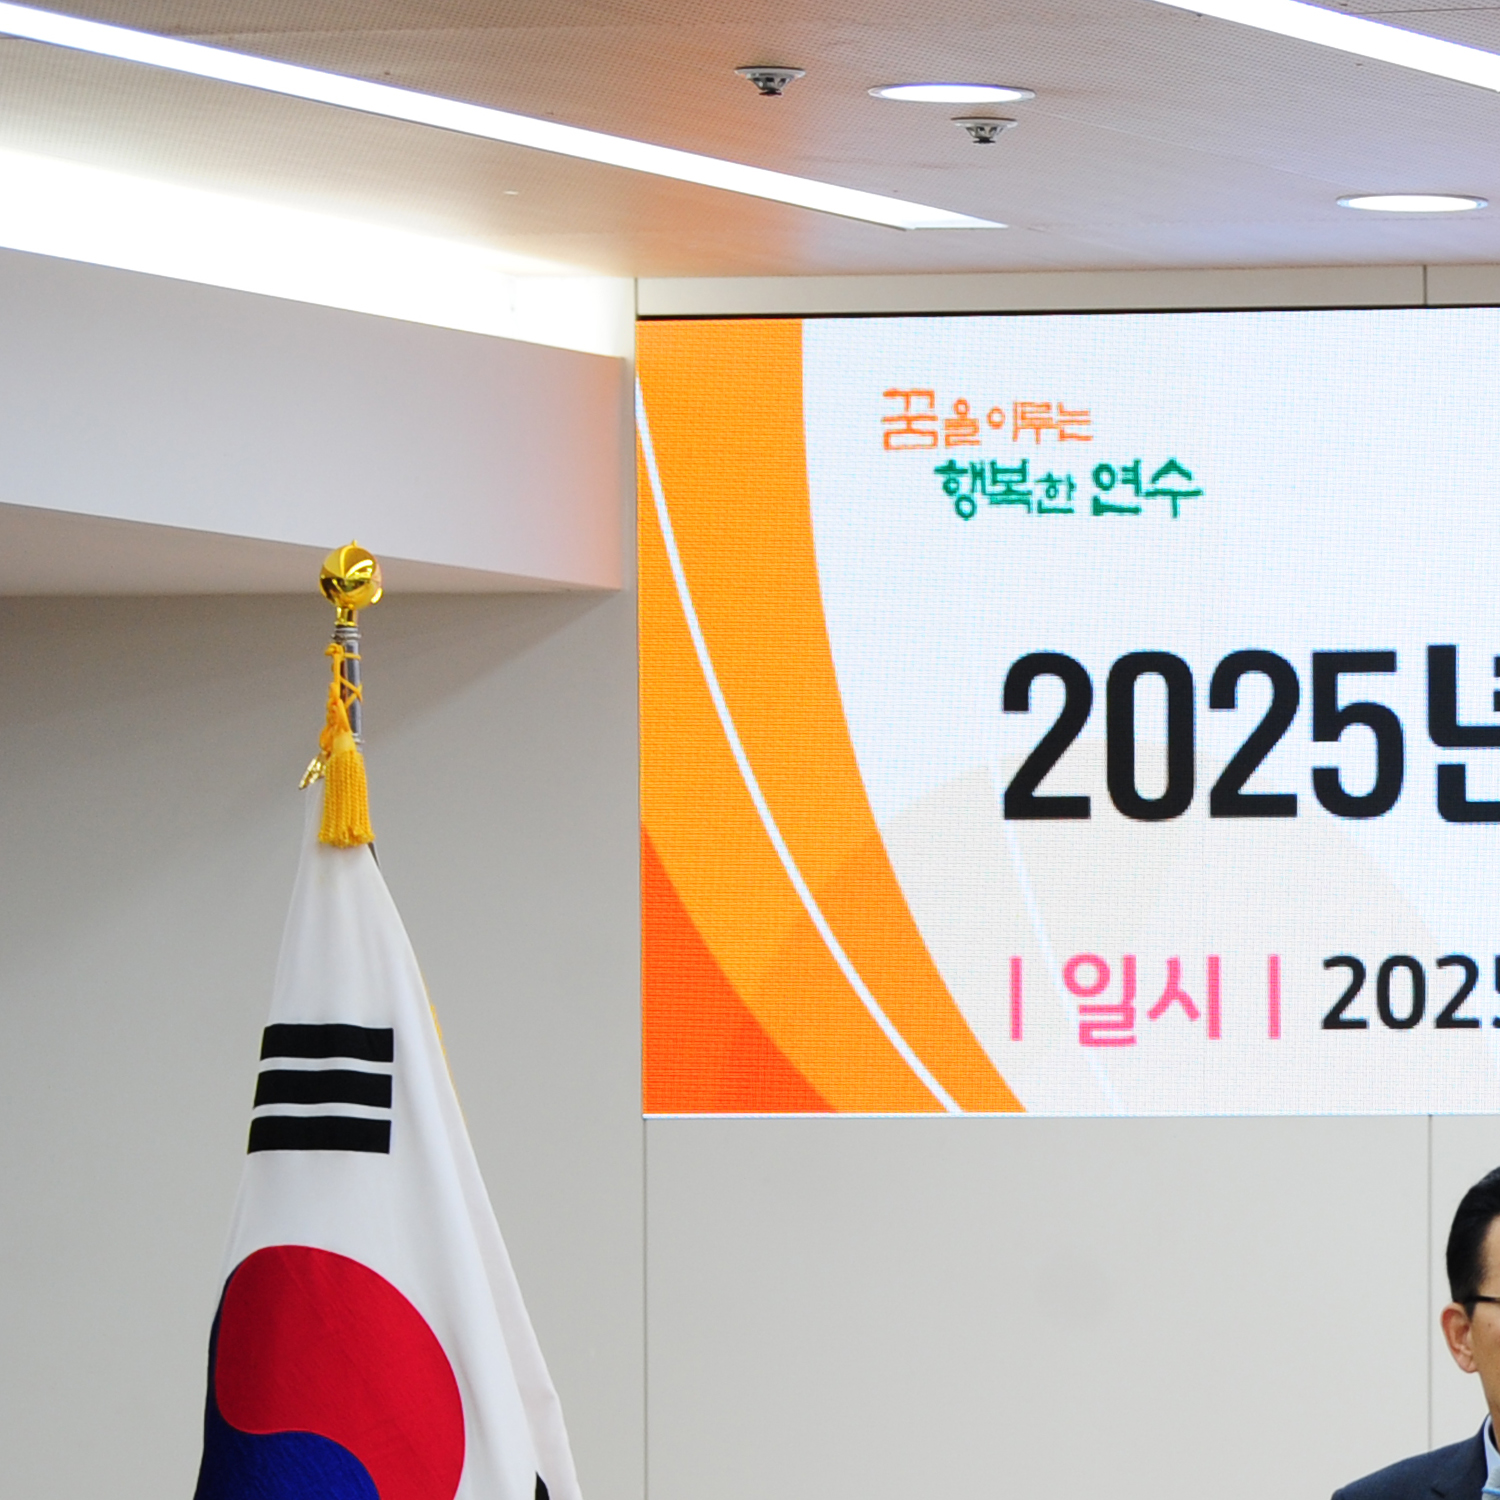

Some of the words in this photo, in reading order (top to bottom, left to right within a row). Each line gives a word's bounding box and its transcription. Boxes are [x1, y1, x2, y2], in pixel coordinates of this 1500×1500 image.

[882, 388, 982, 452] 꿈을
[985, 400, 1094, 446] 이루는
[933, 457, 1079, 522] 행복한
[1090, 456, 1204, 519] 연수
[1062, 953, 1224, 1049] 일시
